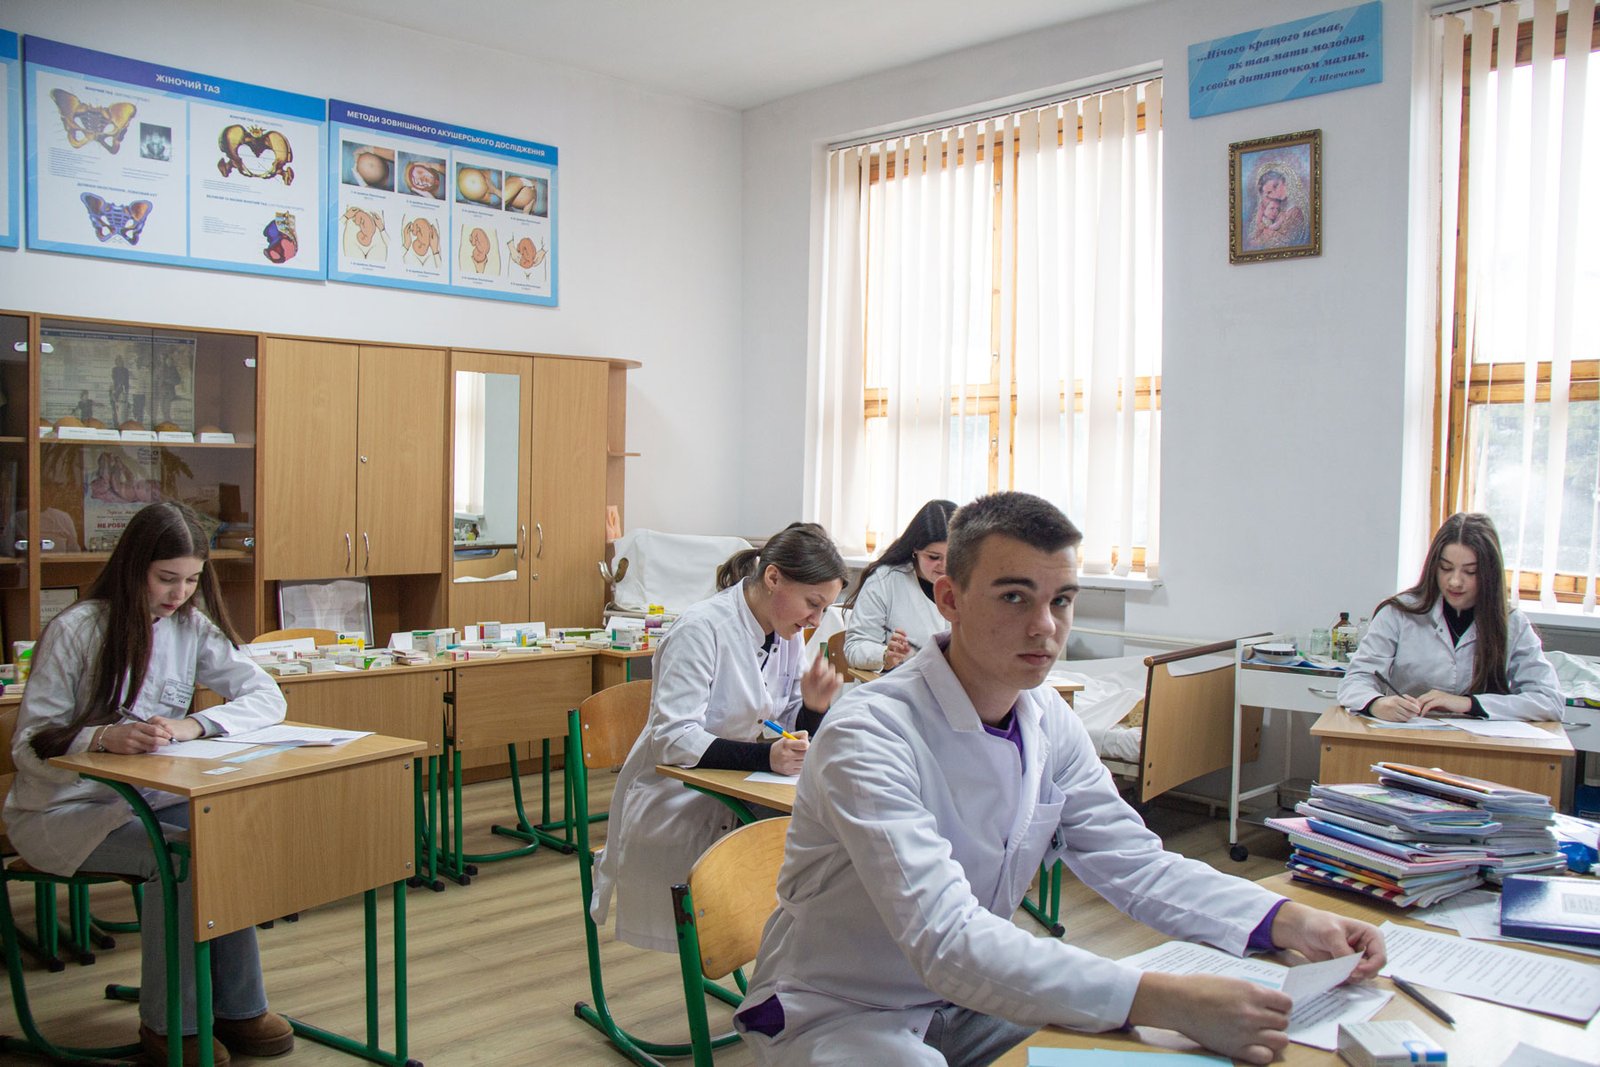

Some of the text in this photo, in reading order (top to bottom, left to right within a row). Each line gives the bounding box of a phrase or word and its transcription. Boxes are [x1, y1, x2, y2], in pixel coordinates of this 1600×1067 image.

[1227, 34, 1366, 72] як тая мати молодая
[1248, 32, 1300, 51] кращого
[1302, 23, 1344, 38] немає,
[155, 73, 221, 94] ЖІНОЧИЙ ТАЗ
[1198, 51, 1370, 94] з своїм дитяточком малим.
[1319, 67, 1366, 82] Шевченко
[346, 109, 546, 157] МЕТОДИ ЗОВНІШНЬОГО АКУШЕРСЬКОГО ДОСЛІДЖЕННЯ
